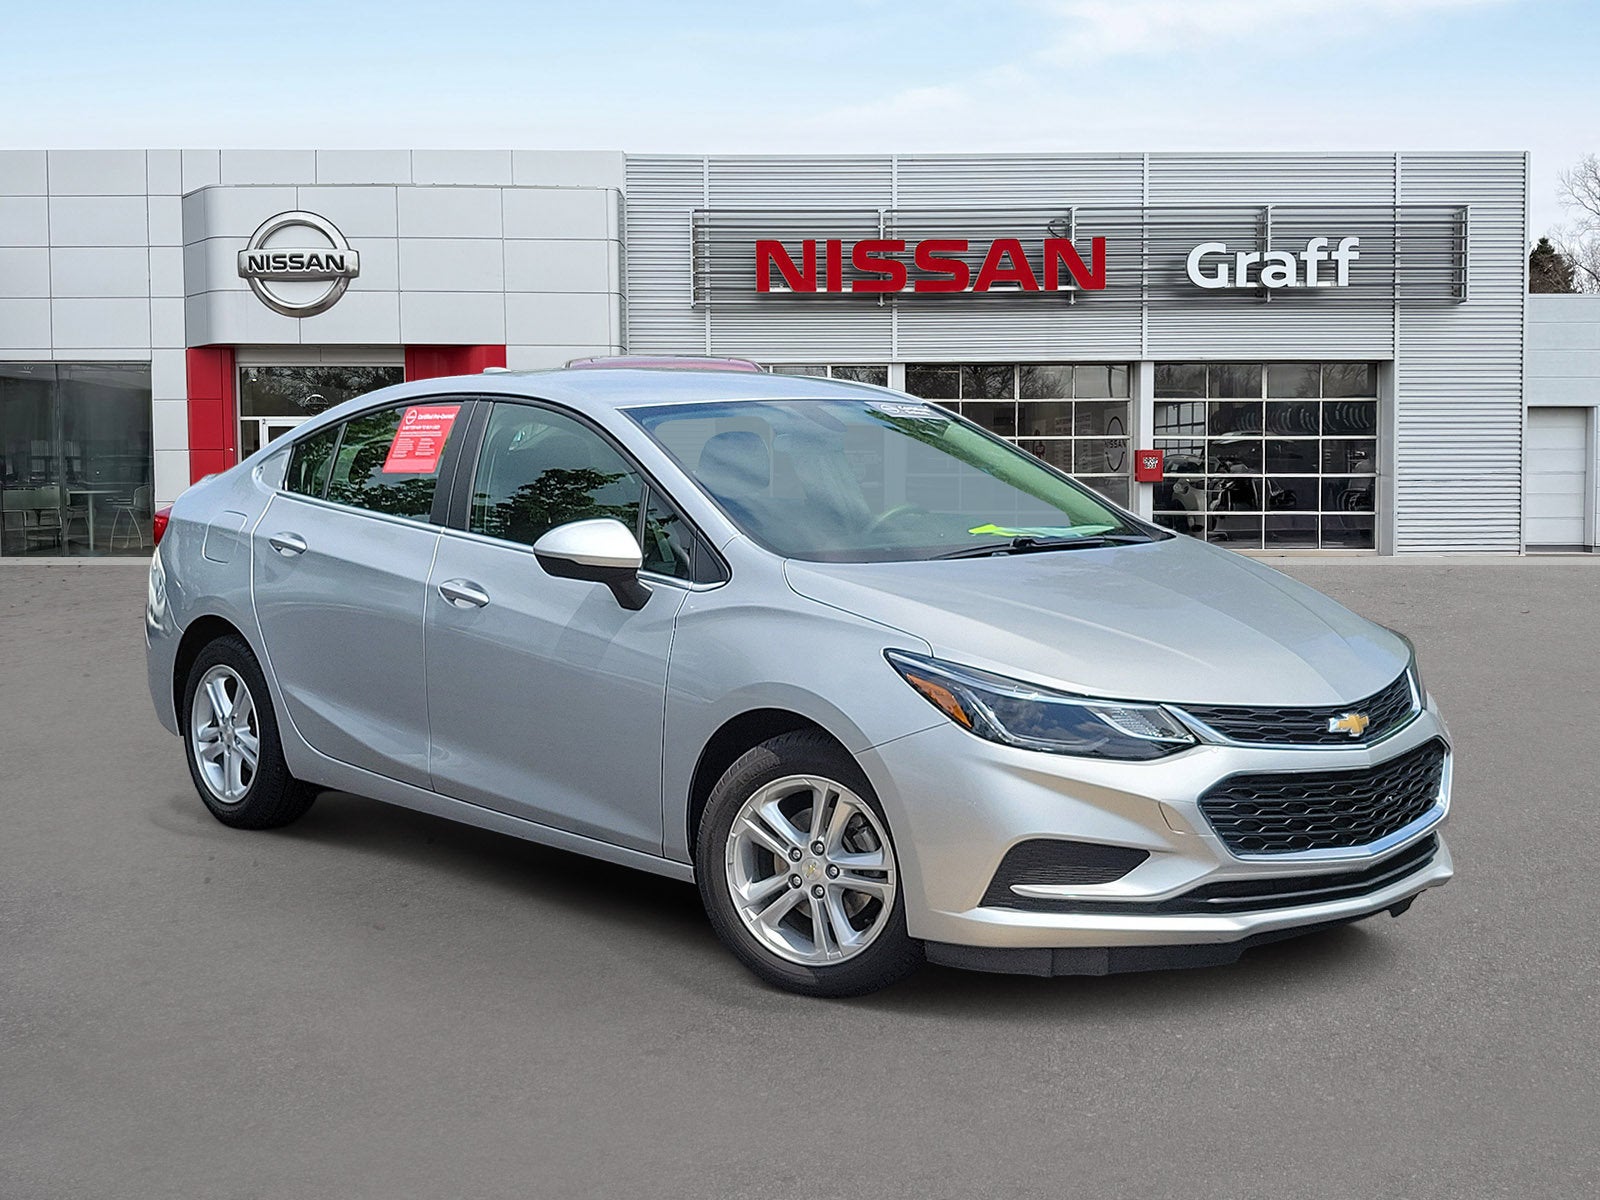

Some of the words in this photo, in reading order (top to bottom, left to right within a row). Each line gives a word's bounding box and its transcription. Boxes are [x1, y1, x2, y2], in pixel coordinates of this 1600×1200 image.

[248, 254, 345, 272] NISSAN
[755, 237, 1106, 292] NISSAN
[1187, 237, 1360, 288] Graff
